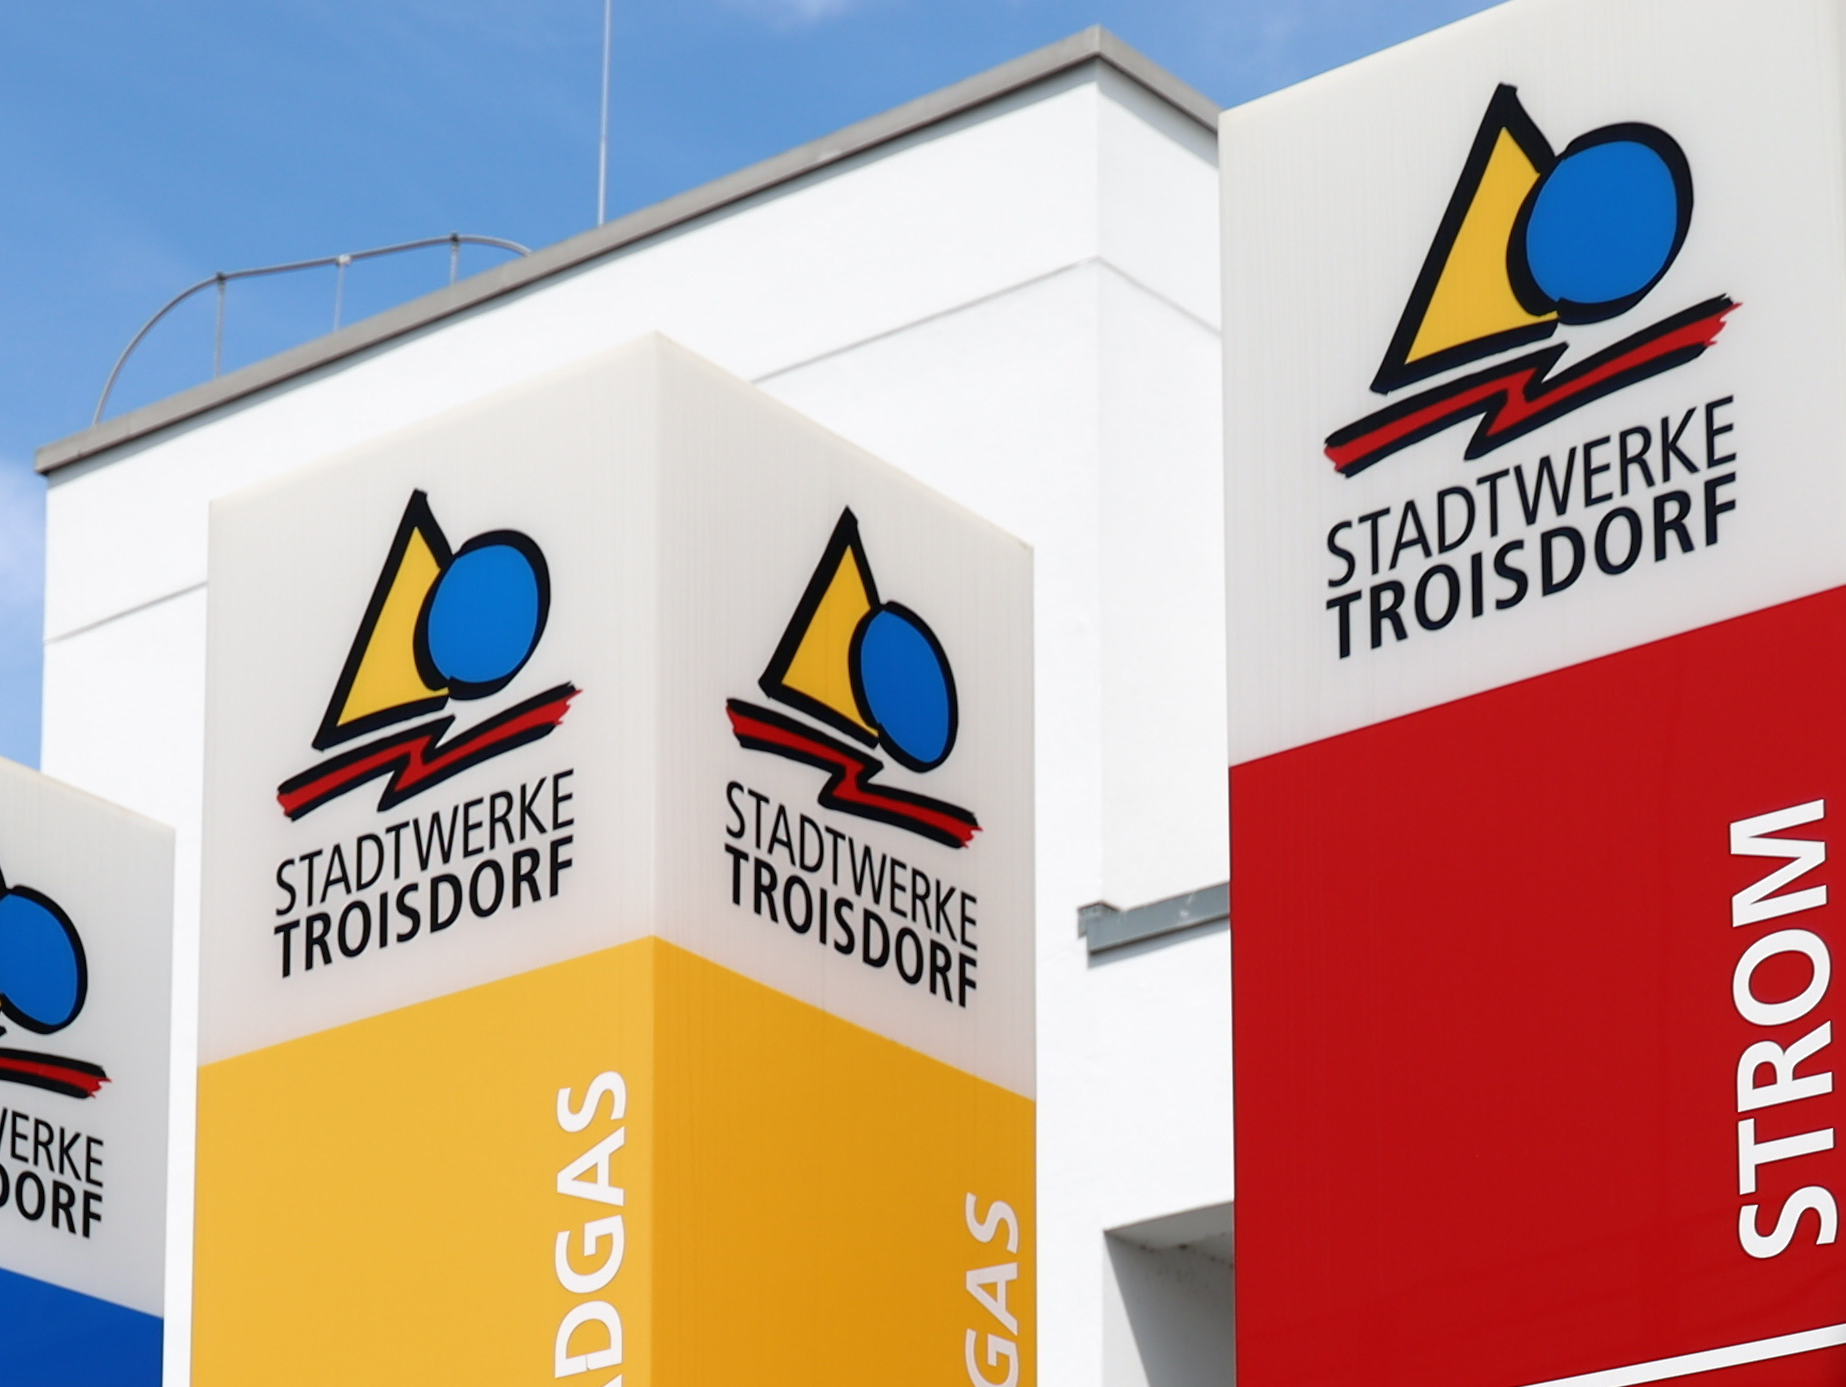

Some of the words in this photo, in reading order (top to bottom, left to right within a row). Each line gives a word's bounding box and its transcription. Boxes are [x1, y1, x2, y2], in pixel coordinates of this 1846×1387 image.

[1326, 396, 1736, 588] STADTWERKE
[1326, 473, 1737, 659] TROISDORF
[274, 836, 574, 978] TROISDORF
[276, 768, 575, 916] STADTWERKE
[725, 782, 978, 951] STADTWERKE
[724, 845, 978, 1009] TROISDORF
[1730, 799, 1838, 1259] STROM
